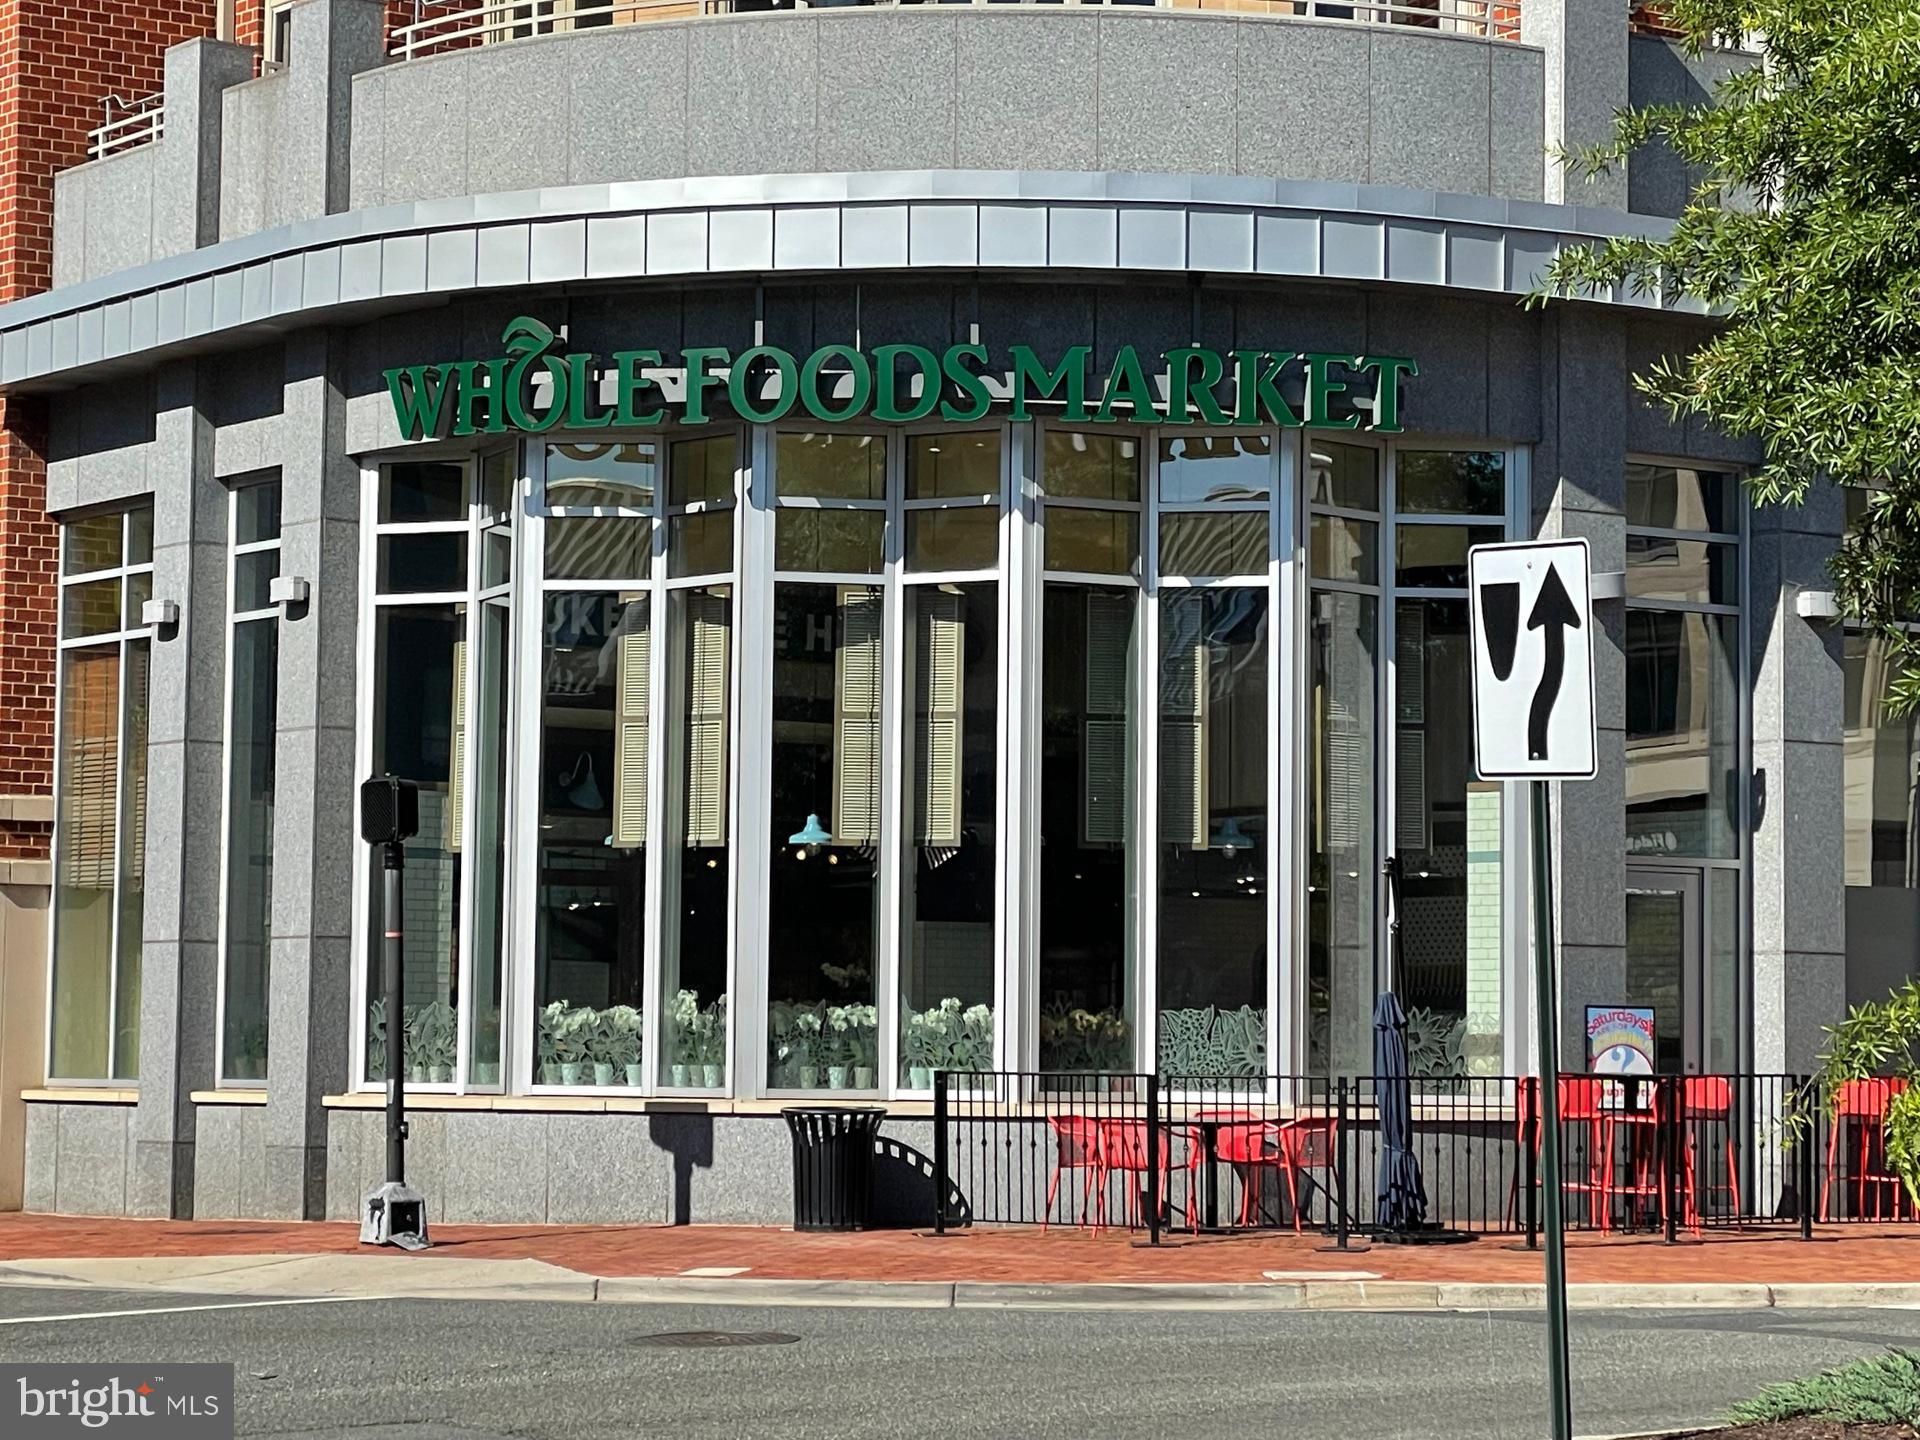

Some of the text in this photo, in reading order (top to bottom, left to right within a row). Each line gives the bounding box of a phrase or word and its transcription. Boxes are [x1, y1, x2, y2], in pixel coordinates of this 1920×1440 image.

[382, 317, 1419, 442] WHOLE FOODS MARKET
